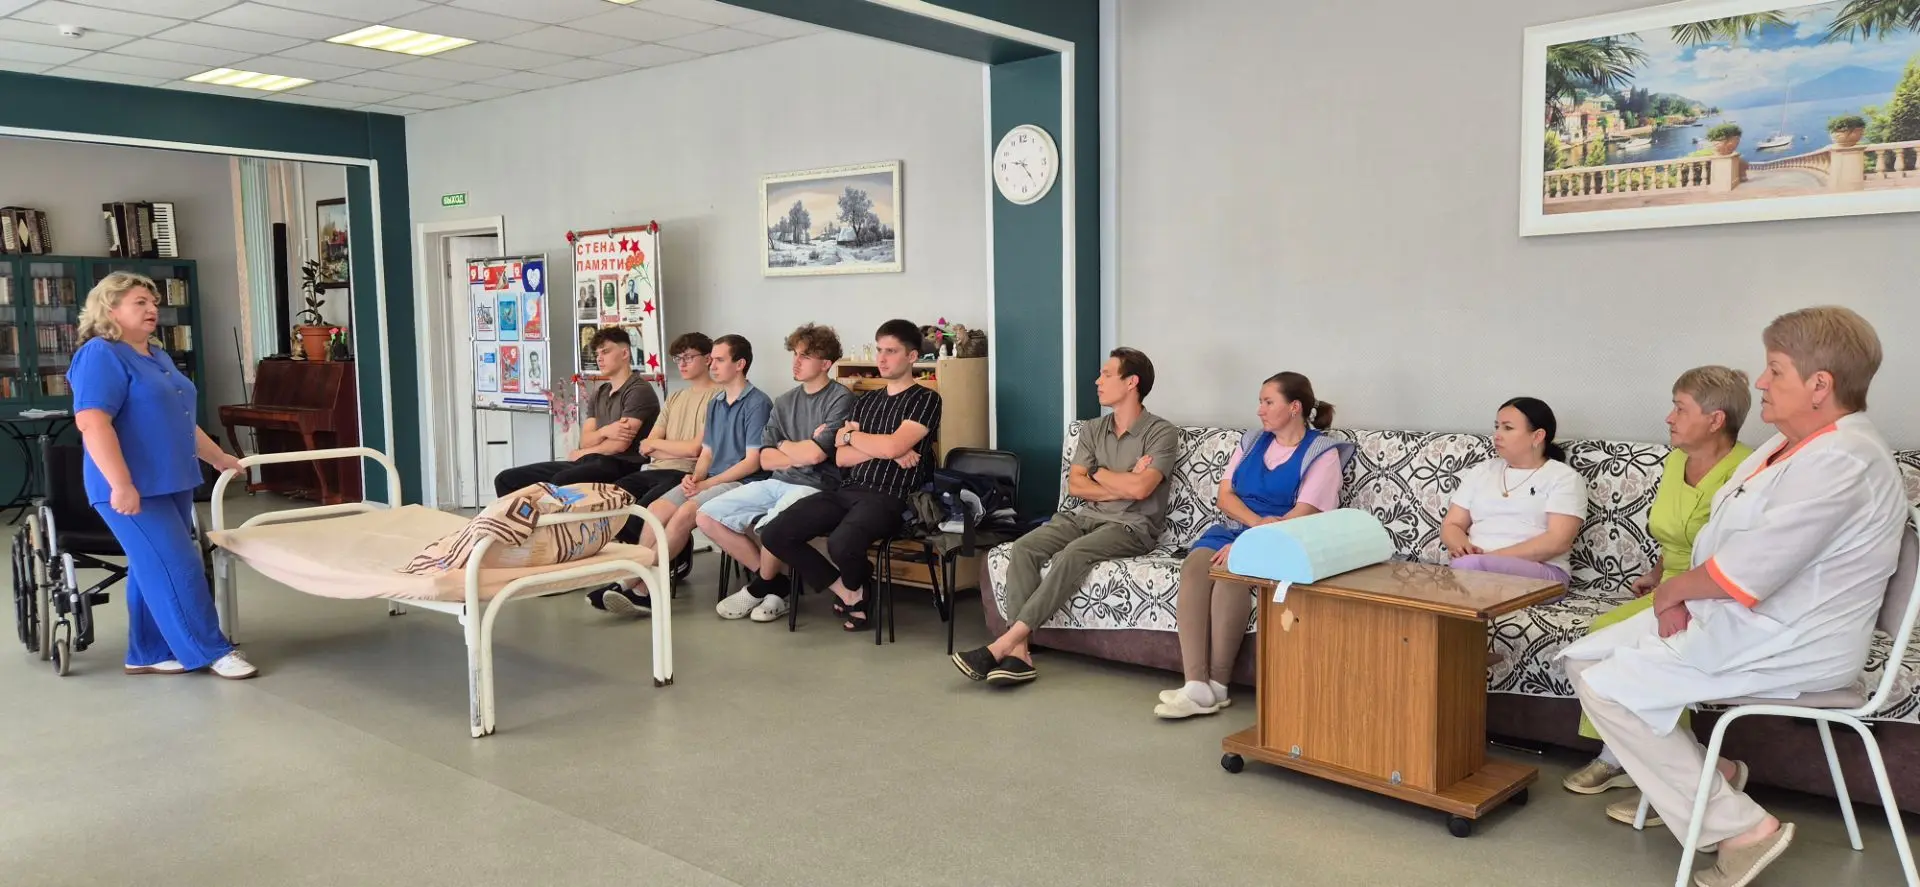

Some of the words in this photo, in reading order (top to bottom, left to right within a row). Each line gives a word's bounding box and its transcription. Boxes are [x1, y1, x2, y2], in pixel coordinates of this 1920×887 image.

[1019, 134, 1028, 143] 12
[577, 241, 616, 256] СТЕНА
[576, 258, 625, 273] ПАМЯТИ
[470, 268, 477, 280] 9
[483, 268, 490, 281] 9
[514, 266, 520, 278] 9
